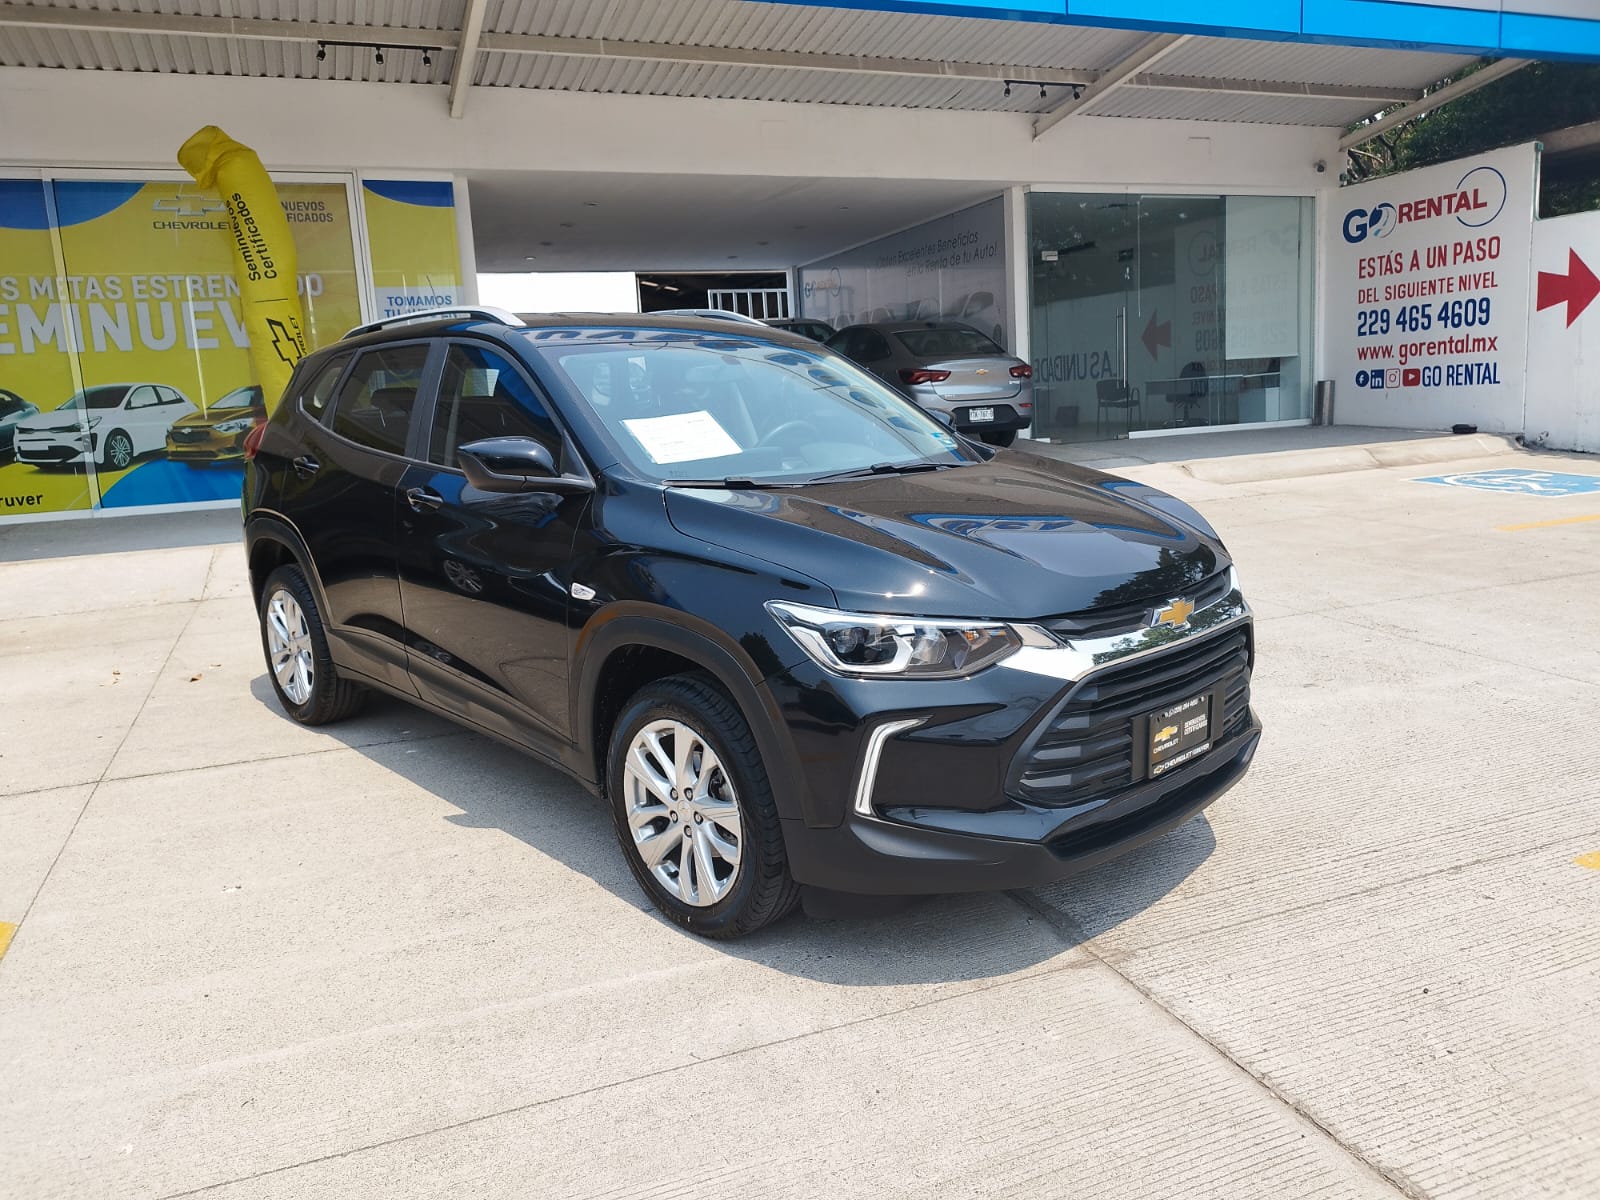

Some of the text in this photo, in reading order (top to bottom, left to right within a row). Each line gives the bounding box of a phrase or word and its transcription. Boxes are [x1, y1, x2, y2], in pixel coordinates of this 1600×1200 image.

[1398, 188, 1488, 224] RENTAL
[225, 200, 261, 281] Seminuevos
[231, 193, 277, 279] Certificados
[937, 230, 979, 253] Beneficios
[949, 253, 962, 266] de
[963, 250, 972, 263] tu
[973, 244, 998, 261] Auto!
[1358, 235, 1501, 279] ESTÁS A UN PASO
[386, 295, 453, 307] TOMAMOS
[1358, 271, 1498, 304] DEL SIGUIENTE NIVEL
[1357, 297, 1491, 337] 229 465 4609
[1398, 334, 1499, 365] gorental.mx
[1422, 366, 1442, 387] GO
[1446, 362, 1500, 386] RENTAL
